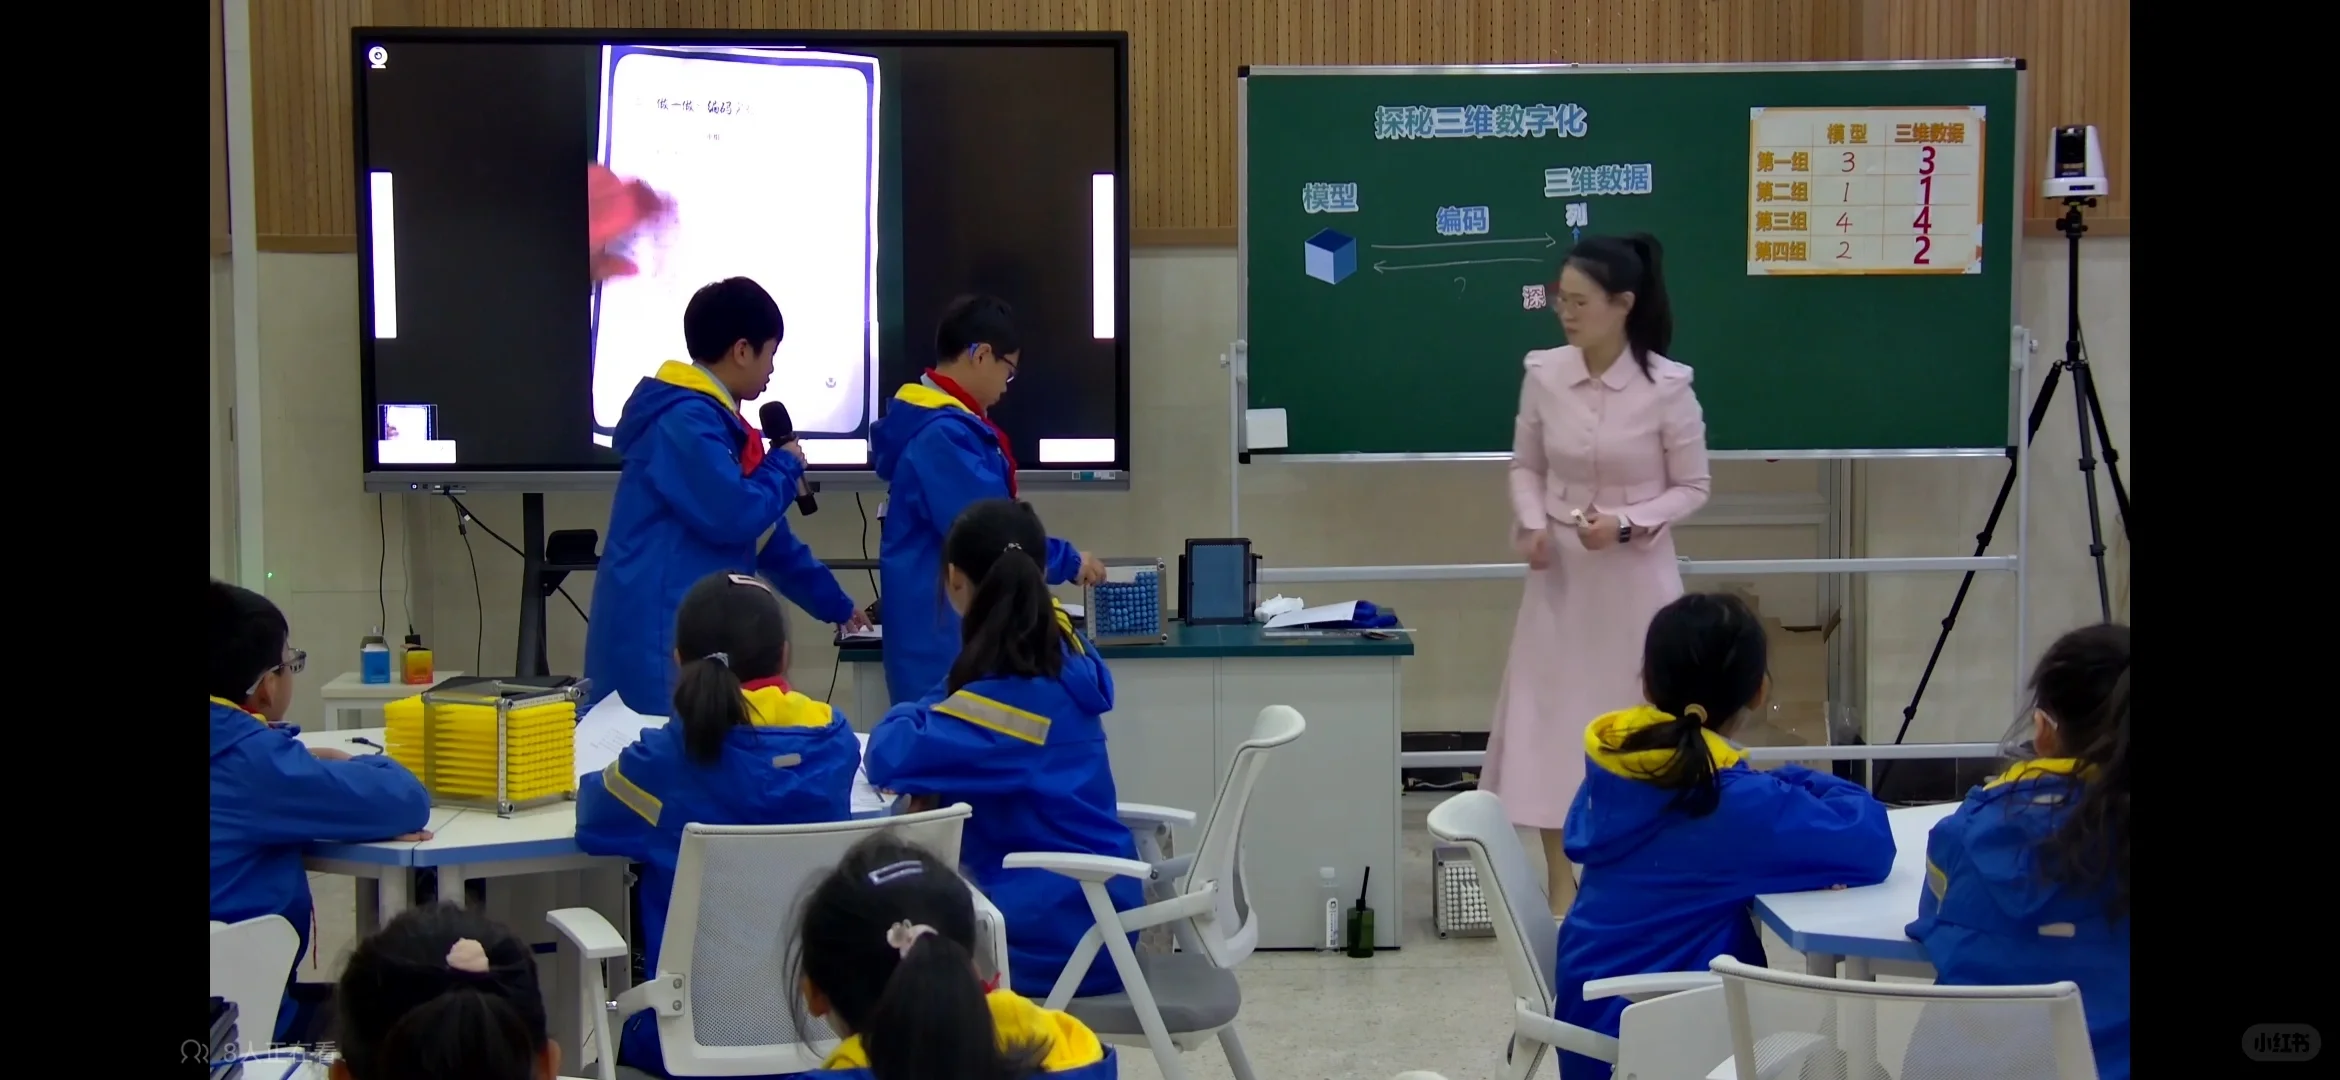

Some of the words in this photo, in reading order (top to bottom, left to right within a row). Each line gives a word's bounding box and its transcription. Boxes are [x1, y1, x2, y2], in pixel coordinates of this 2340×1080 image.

[1375, 103, 1587, 139] 探秘三维数字化
[1895, 122, 1965, 144] 三维数据
[1756, 151, 1809, 172] 第一组
[1841, 151, 1856, 173] 3
[1918, 146, 1936, 175] 3
[1545, 163, 1652, 197] 三维数据
[1756, 181, 1808, 202] 第二组
[1842, 182, 1850, 202] 1
[1920, 176, 1932, 205] 1
[1303, 183, 1358, 213] 模型
[1436, 206, 1489, 235] 编码
[1566, 202, 1588, 227] 列
[1755, 210, 1807, 232] 第三组
[1836, 211, 1853, 233] 4
[1913, 206, 1932, 234] 4
[1755, 241, 1807, 262] 第四组
[1836, 241, 1852, 259] 2
[1914, 235, 1931, 264] 2
